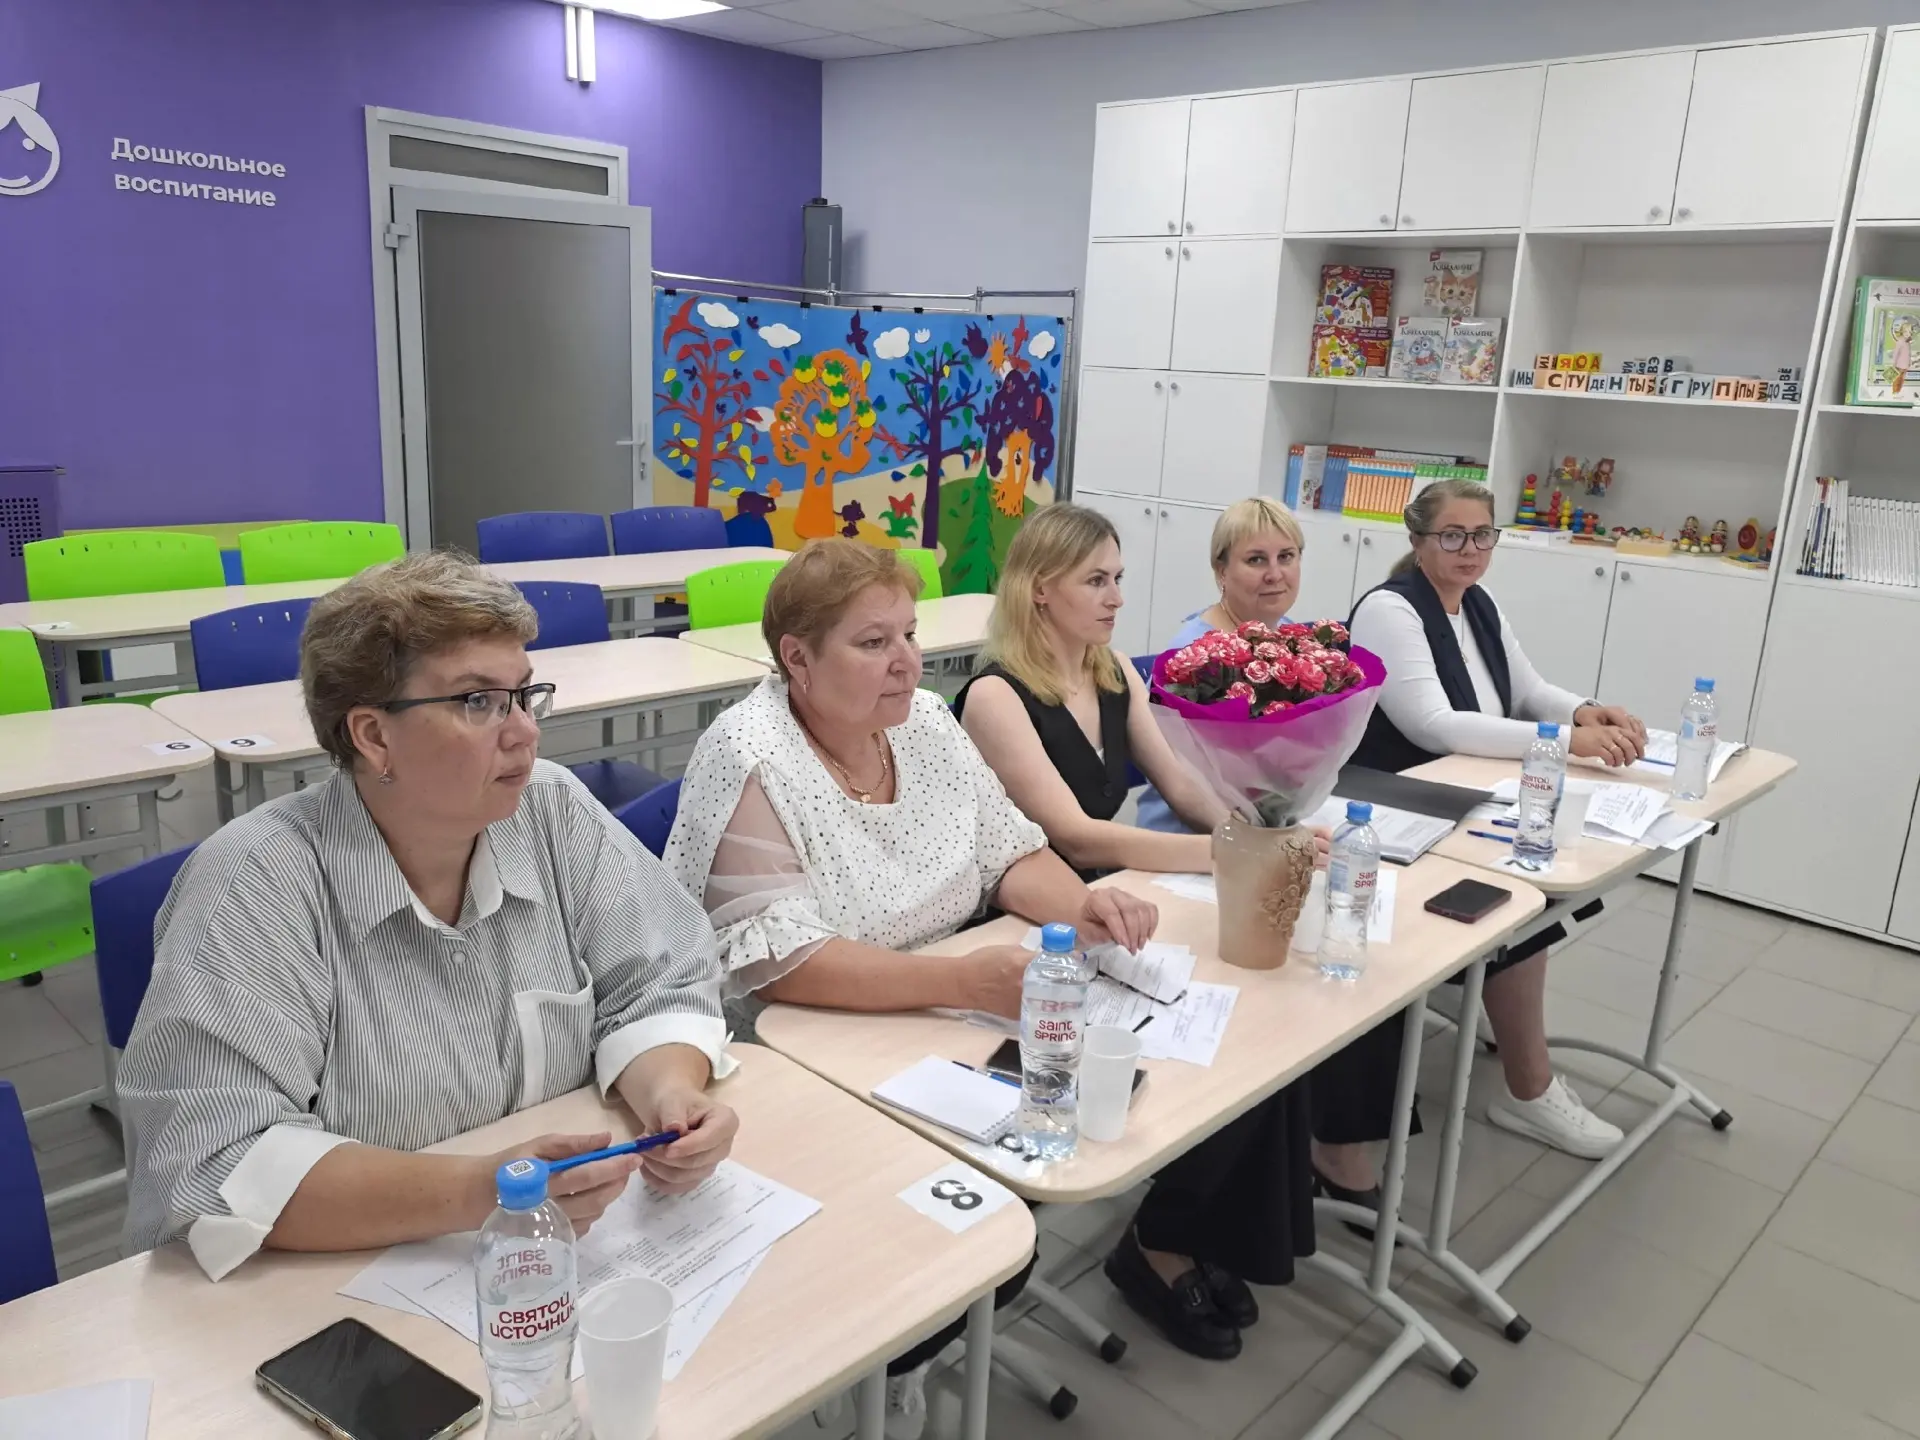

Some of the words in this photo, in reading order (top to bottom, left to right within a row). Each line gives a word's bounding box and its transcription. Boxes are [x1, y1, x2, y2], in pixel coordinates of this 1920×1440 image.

[111, 137, 287, 178] Дошкольное
[115, 173, 277, 207] воспитание
[1515, 371, 1534, 386] МЫ
[1034, 1030, 1077, 1042] SPRING
[498, 1291, 570, 1324] СВЯТОЙ
